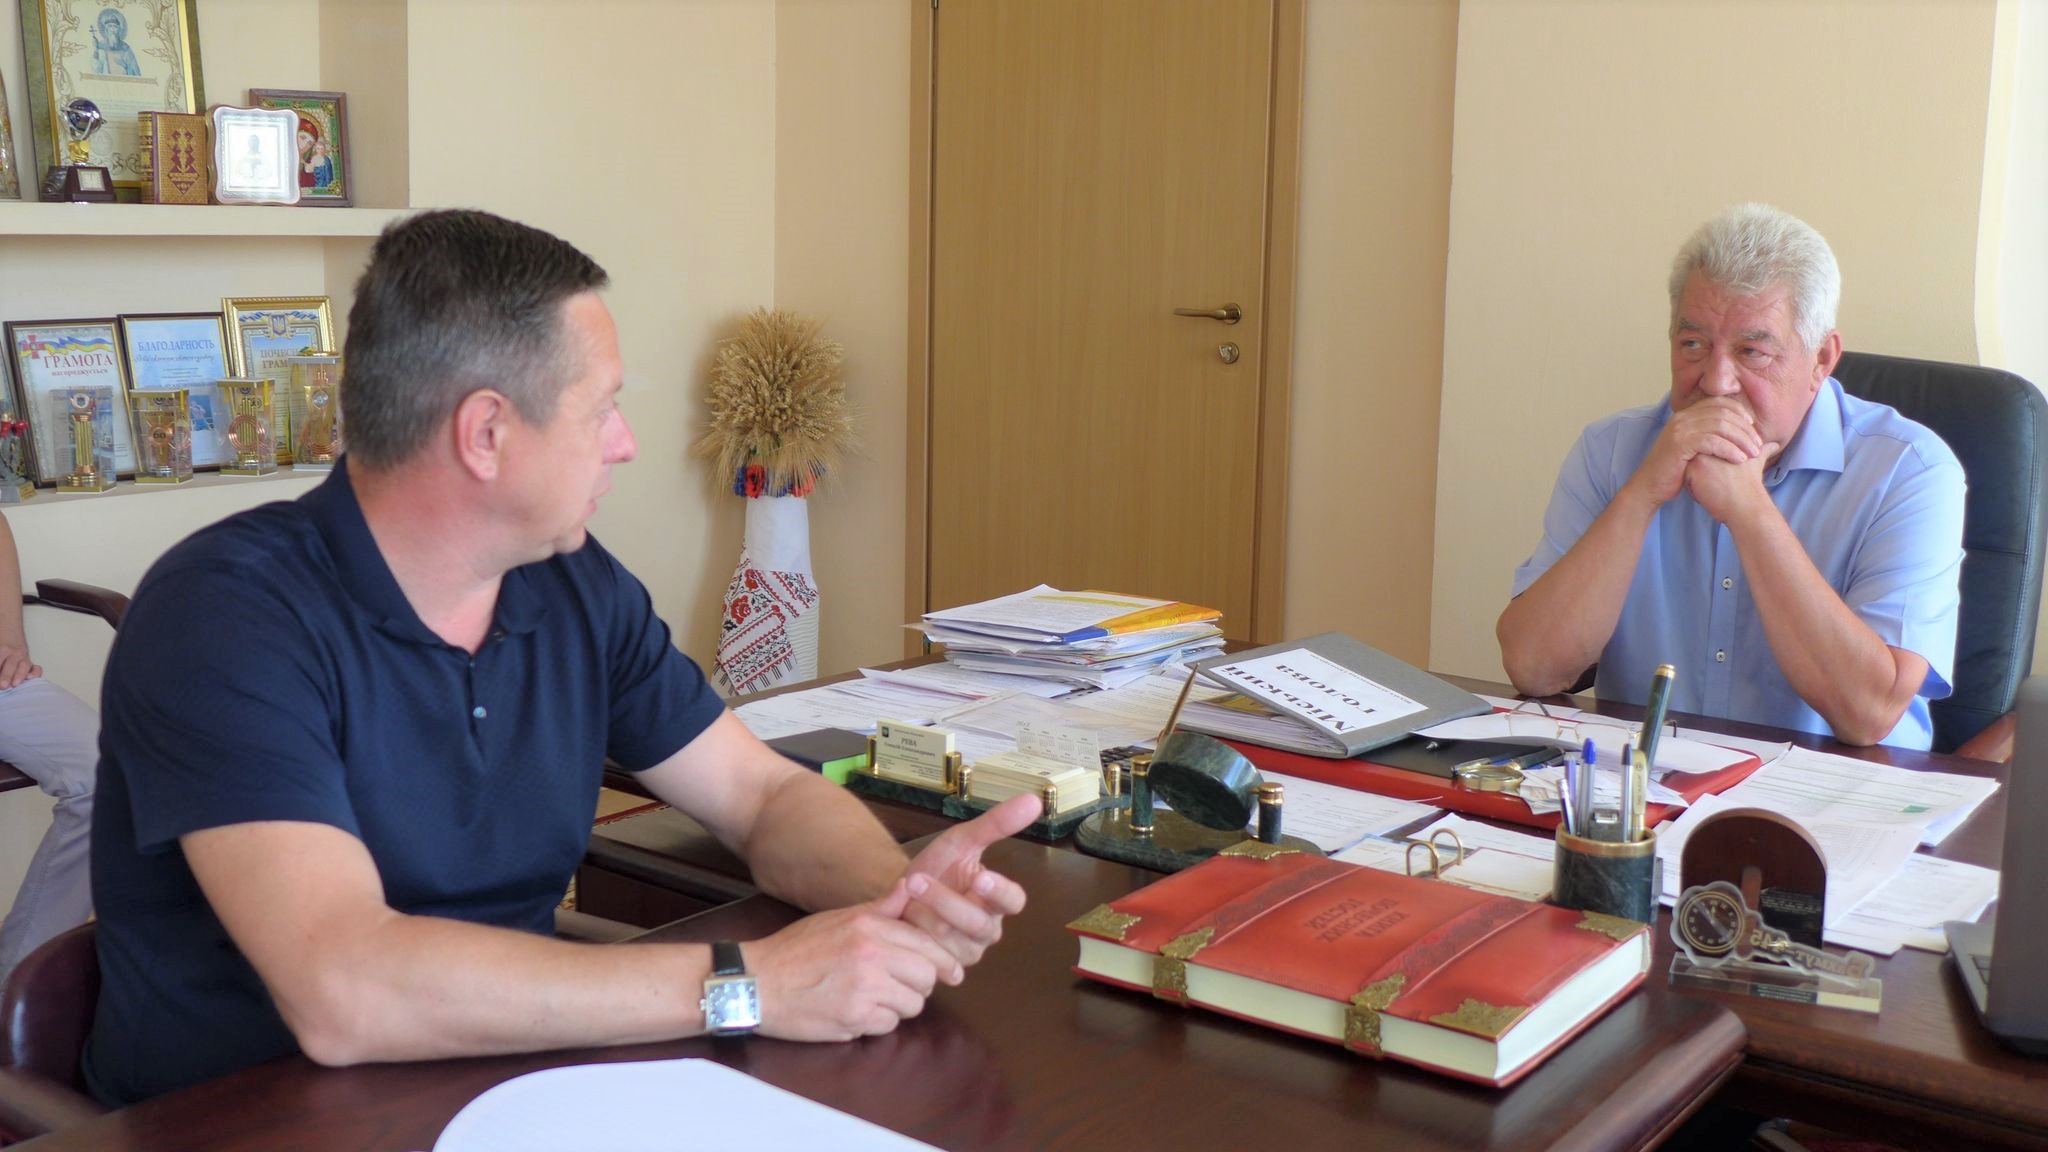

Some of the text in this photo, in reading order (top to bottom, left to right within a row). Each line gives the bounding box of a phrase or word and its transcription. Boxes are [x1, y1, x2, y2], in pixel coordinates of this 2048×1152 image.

[137, 339, 215, 353] БЛАГОДАРНОСТЬ
[43, 353, 113, 369] ГРАМОТА
[263, 359, 289, 369] ГРАМ
[1222, 665, 1355, 732] Міський
